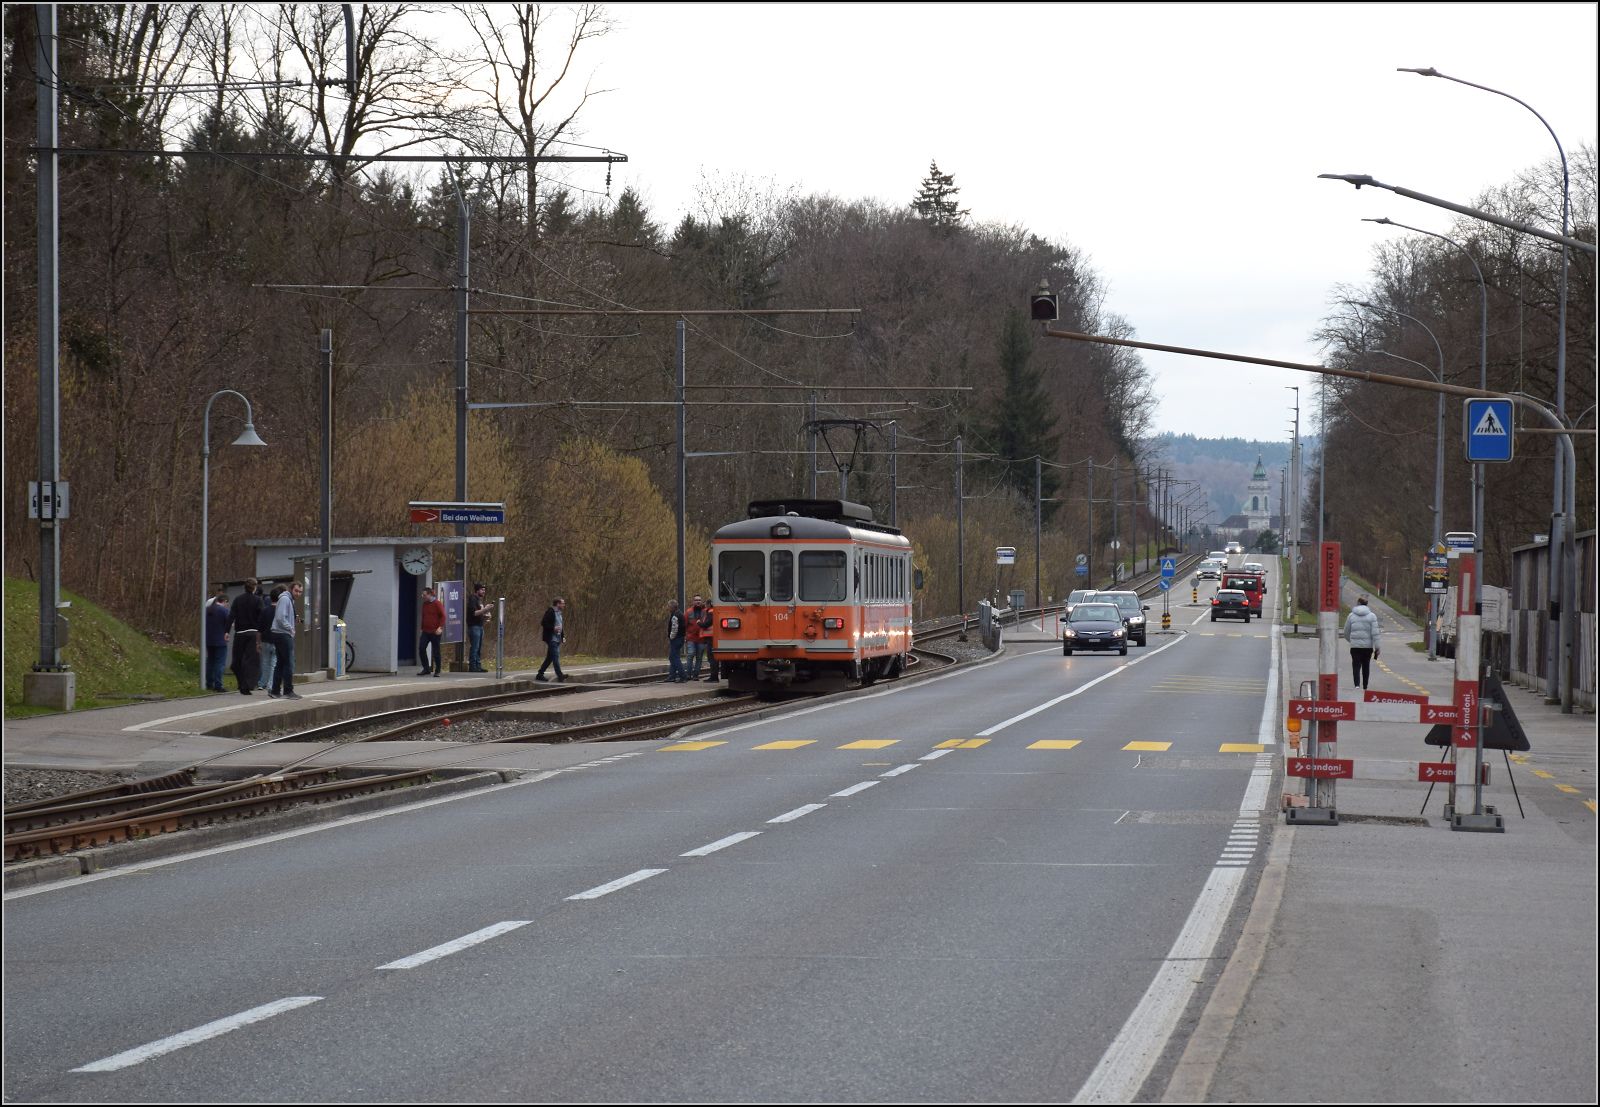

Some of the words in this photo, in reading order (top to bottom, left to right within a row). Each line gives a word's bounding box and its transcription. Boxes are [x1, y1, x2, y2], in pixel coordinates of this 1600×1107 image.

[469, 514, 498, 522] Weihern
[1325, 547, 1335, 607] CANDONI
[773, 613, 789, 621] 104
[1306, 705, 1343, 714] candoni
[1463, 694, 1471, 730] candoni
[1305, 763, 1342, 771] candoni
